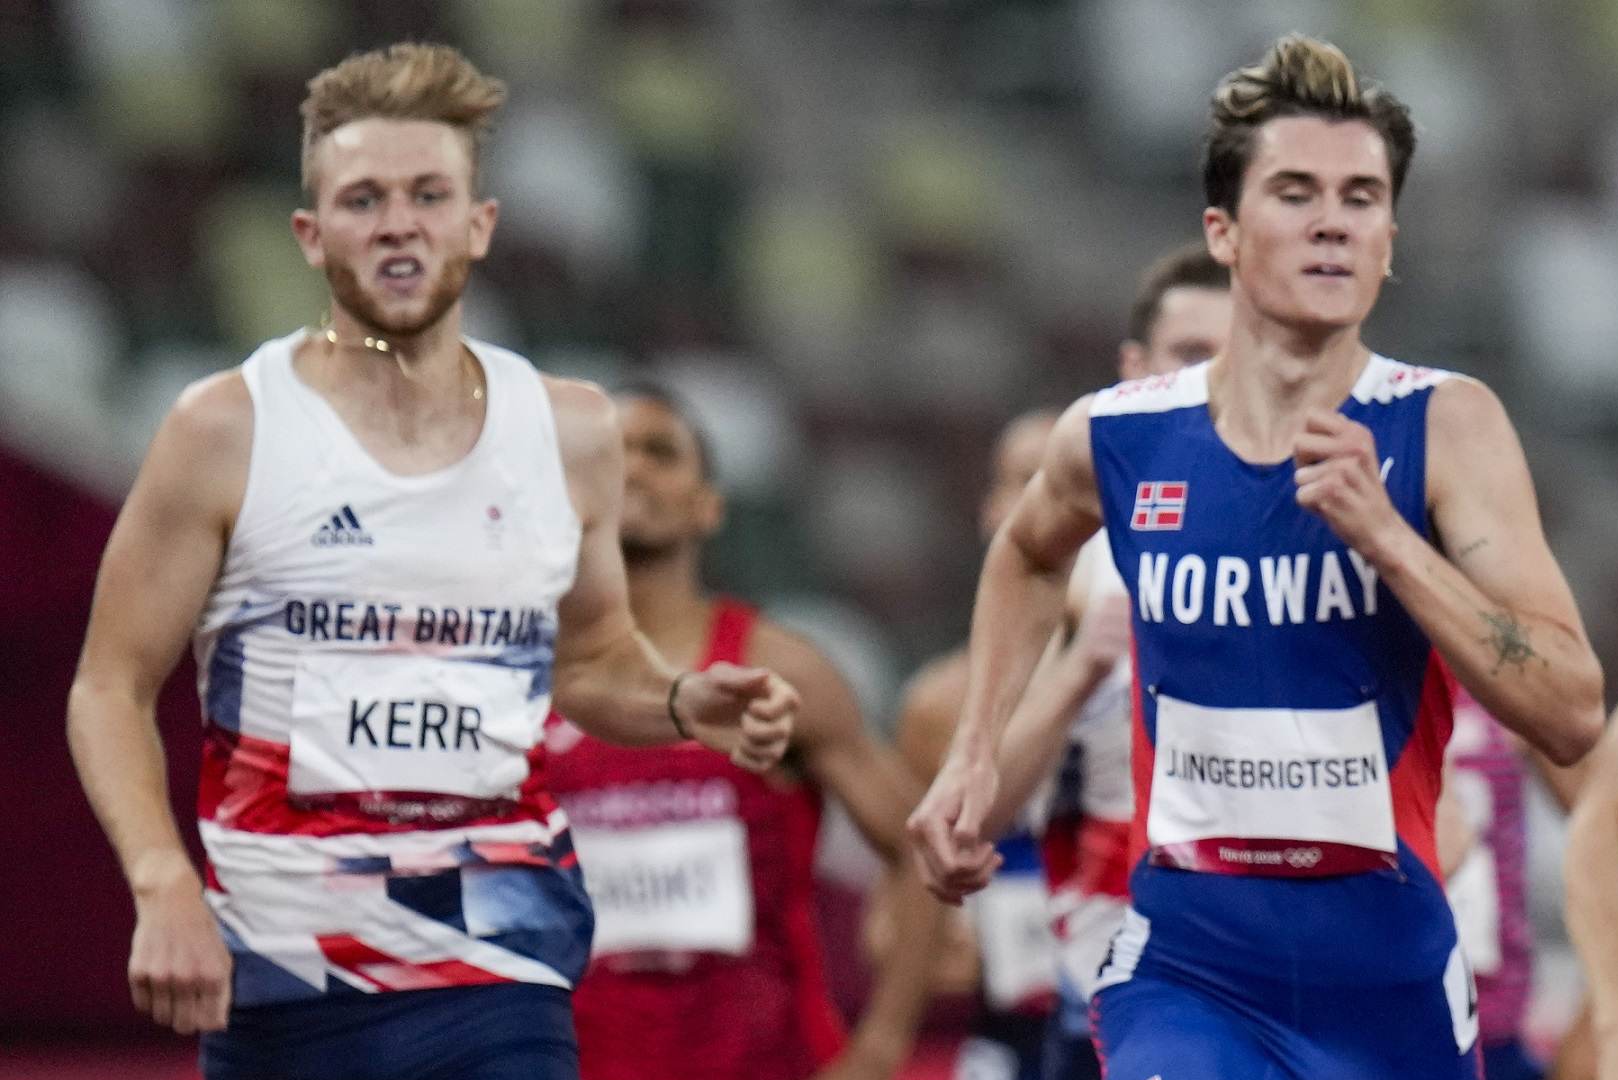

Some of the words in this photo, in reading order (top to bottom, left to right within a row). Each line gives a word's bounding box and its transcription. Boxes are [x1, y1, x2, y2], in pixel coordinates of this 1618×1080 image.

[1137, 551, 1379, 627] NORWAY
[286, 600, 402, 642] GREAT
[348, 698, 483, 751] KERR
